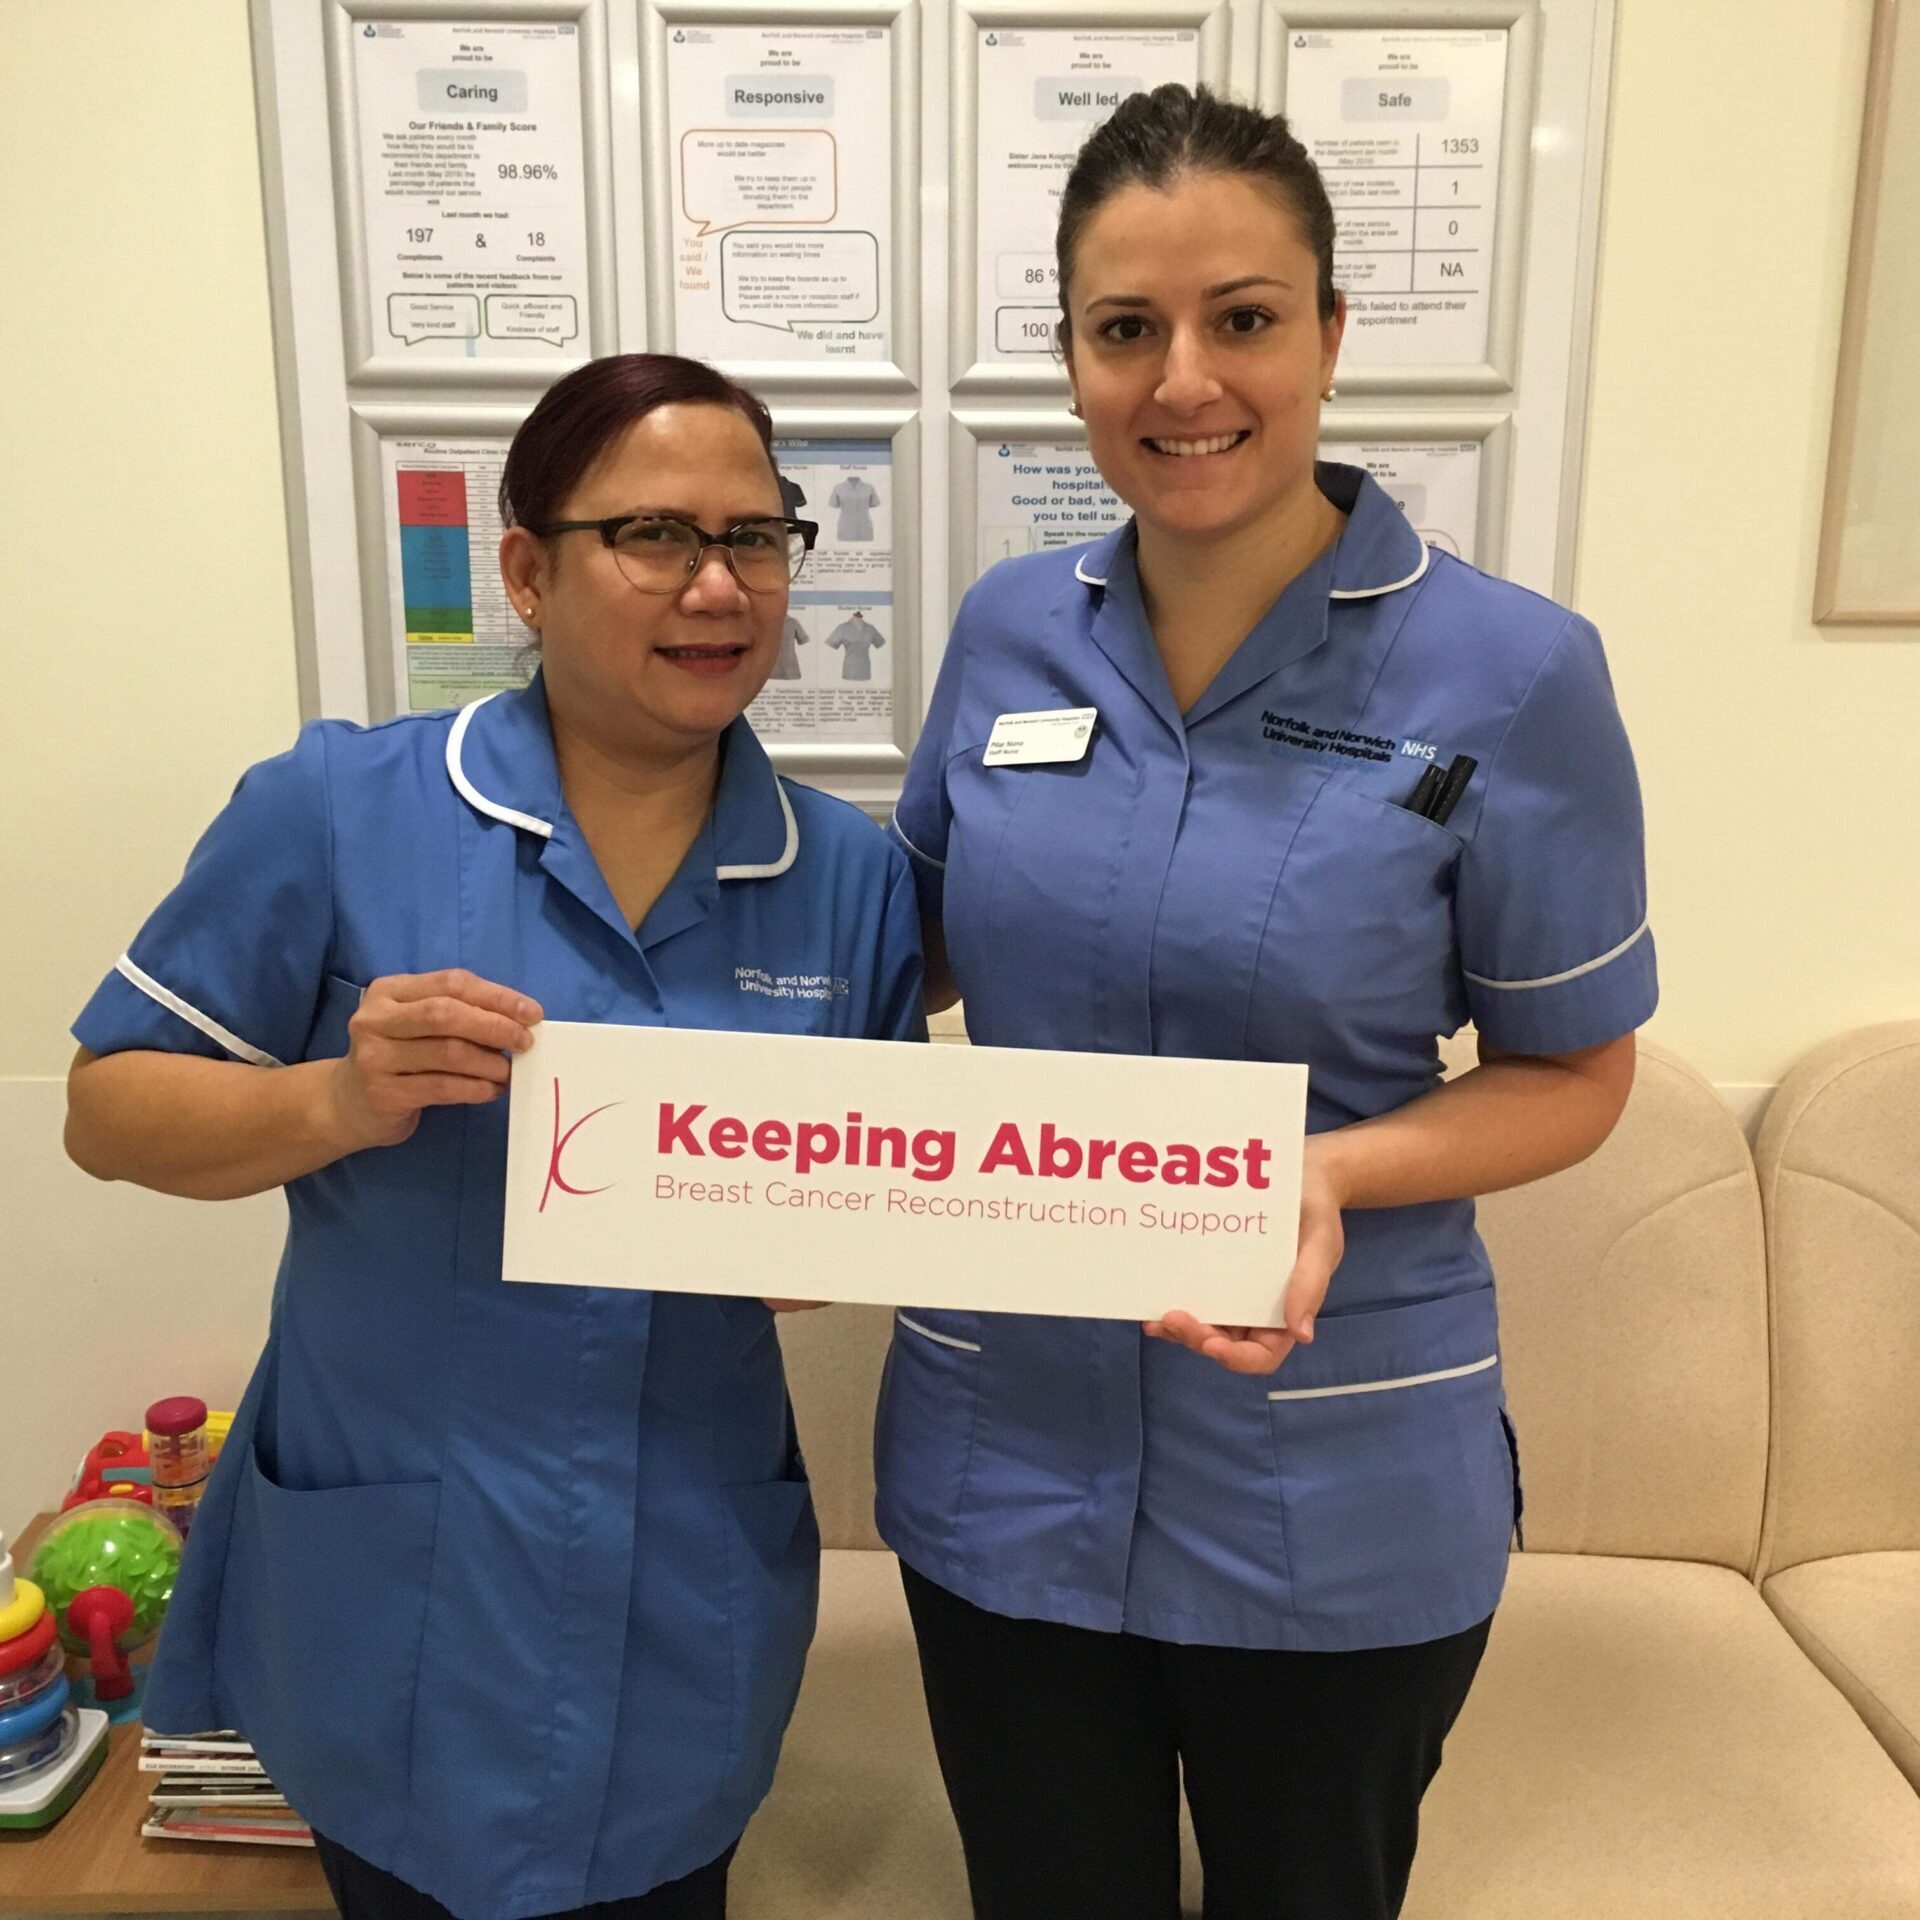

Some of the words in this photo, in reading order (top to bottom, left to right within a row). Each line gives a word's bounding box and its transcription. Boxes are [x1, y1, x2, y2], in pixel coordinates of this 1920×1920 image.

[459, 44, 470, 52] We
[452, 54, 473, 62] proud
[447, 85, 498, 102] Caring
[734, 90, 824, 106] Responsive
[1059, 92, 1090, 106] Well
[1096, 92, 1118, 106] led
[1378, 93, 1412, 107] Safe
[409, 121, 426, 130] Our
[429, 122, 464, 130] Friends
[467, 122, 473, 130] &
[477, 122, 507, 132] Family
[510, 123, 537, 131] Score
[1441, 139, 1479, 154] 1353
[498, 164, 557, 180] 98.96%
[1452, 181, 1458, 195] 1
[1449, 221, 1458, 235] 0
[406, 228, 433, 243] 197
[476, 233, 487, 248] &
[527, 232, 545, 246] 18
[684, 239, 703, 248] You
[397, 254, 442, 262] Compliments
[680, 253, 701, 262] said
[686, 267, 702, 276] We
[1025, 269, 1044, 283] 86
[1440, 262, 1464, 277] NA
[680, 281, 709, 290] found
[1370, 301, 1396, 311] failed
[1399, 302, 1409, 311] to
[1412, 301, 1442, 311] attend
[1445, 301, 1466, 310] their
[1357, 316, 1417, 326] appointment
[797, 330, 813, 340] We
[817, 330, 832, 340] did
[836, 330, 855, 340] and
[859, 331, 883, 340] have
[1022, 323, 1048, 337] 100
[826, 345, 855, 354] learnt
[1013, 464, 1042, 474] How
[1046, 466, 1071, 474] was
[1076, 465, 1099, 476] you
[1053, 480, 1104, 491] hospital
[1012, 496, 1046, 505] Good
[1051, 497, 1064, 505] or
[1069, 496, 1096, 506] bad,
[1101, 497, 1117, 505] we
[1033, 512, 1057, 523] you
[1062, 512, 1073, 521] to
[1078, 512, 1097, 521] tell
[1261, 711, 1310, 734] Norfolk
[1313, 726, 1340, 740] and
[1339, 731, 1396, 750] Norwich
[1263, 727, 1328, 753] University
[1330, 741, 1392, 763] Hospitals
[1401, 741, 1438, 760] NHS
[735, 967, 773, 985] Norfolk
[776, 975, 798, 985] and
[800, 975, 832, 986] Norwi
[740, 981, 795, 998] University
[656, 1101, 957, 1184] Keeping
[978, 1121, 1273, 1192] Abreast
[655, 1174, 753, 1205] Breast
[765, 1181, 876, 1210] Cancer
[887, 1188, 1127, 1226] Reconstruction
[1139, 1203, 1268, 1236] Support
